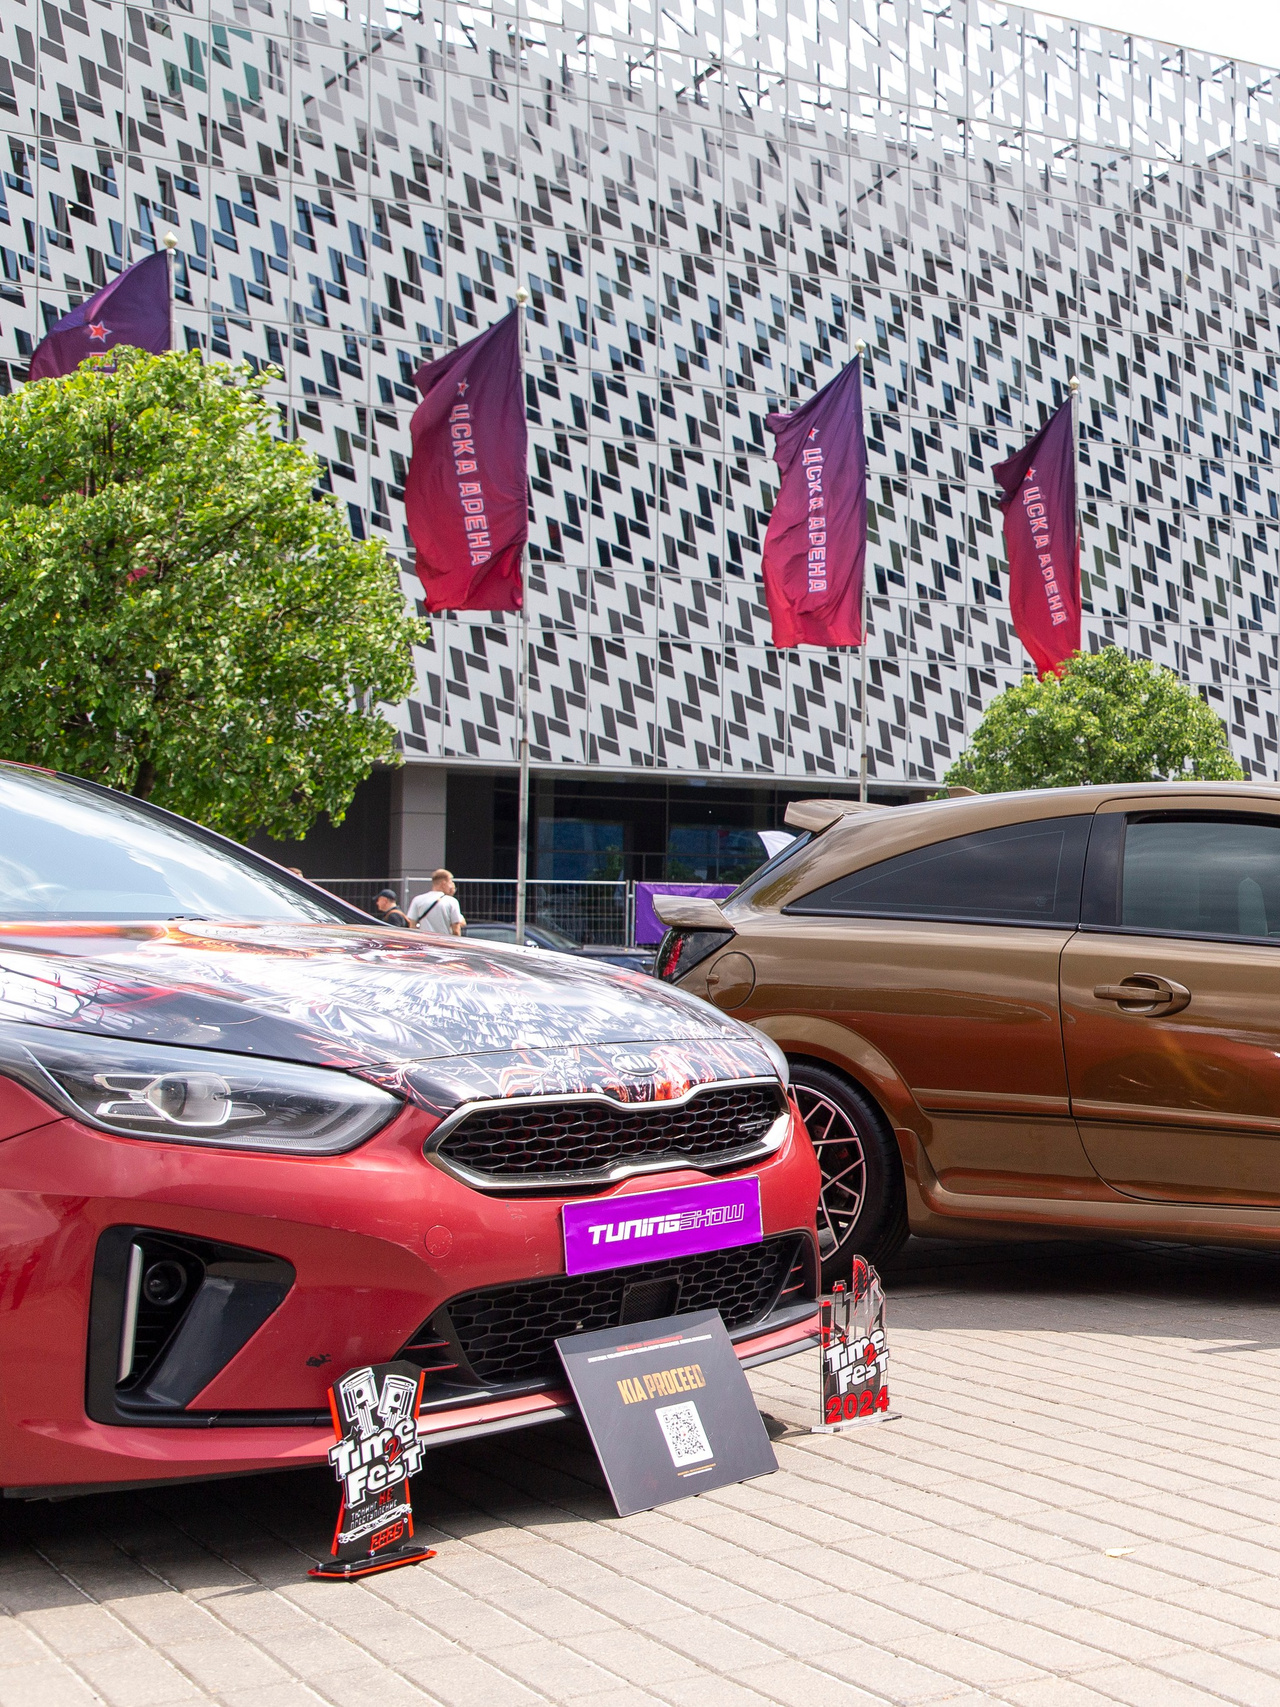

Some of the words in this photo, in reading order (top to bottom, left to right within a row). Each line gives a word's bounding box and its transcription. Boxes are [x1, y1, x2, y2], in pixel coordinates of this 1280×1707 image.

[449, 403, 478, 476] ЦСКА
[802, 448, 824, 512] ЦСКА
[458, 482, 492, 566] АРЕНА
[808, 516, 828, 593] АРЕНА
[1023, 486, 1050, 549] ЦСКА
[1039, 553, 1068, 627] АРЕНА
[619, 1052, 657, 1071] KIA
[864, 1343, 879, 1366] 2
[617, 1376, 648, 1404] KIA
[643, 1364, 707, 1399] PROCEED
[826, 1385, 891, 1424] 2024
[385, 1435, 404, 1465] 2
[379, 1486, 395, 1506] НЕ
